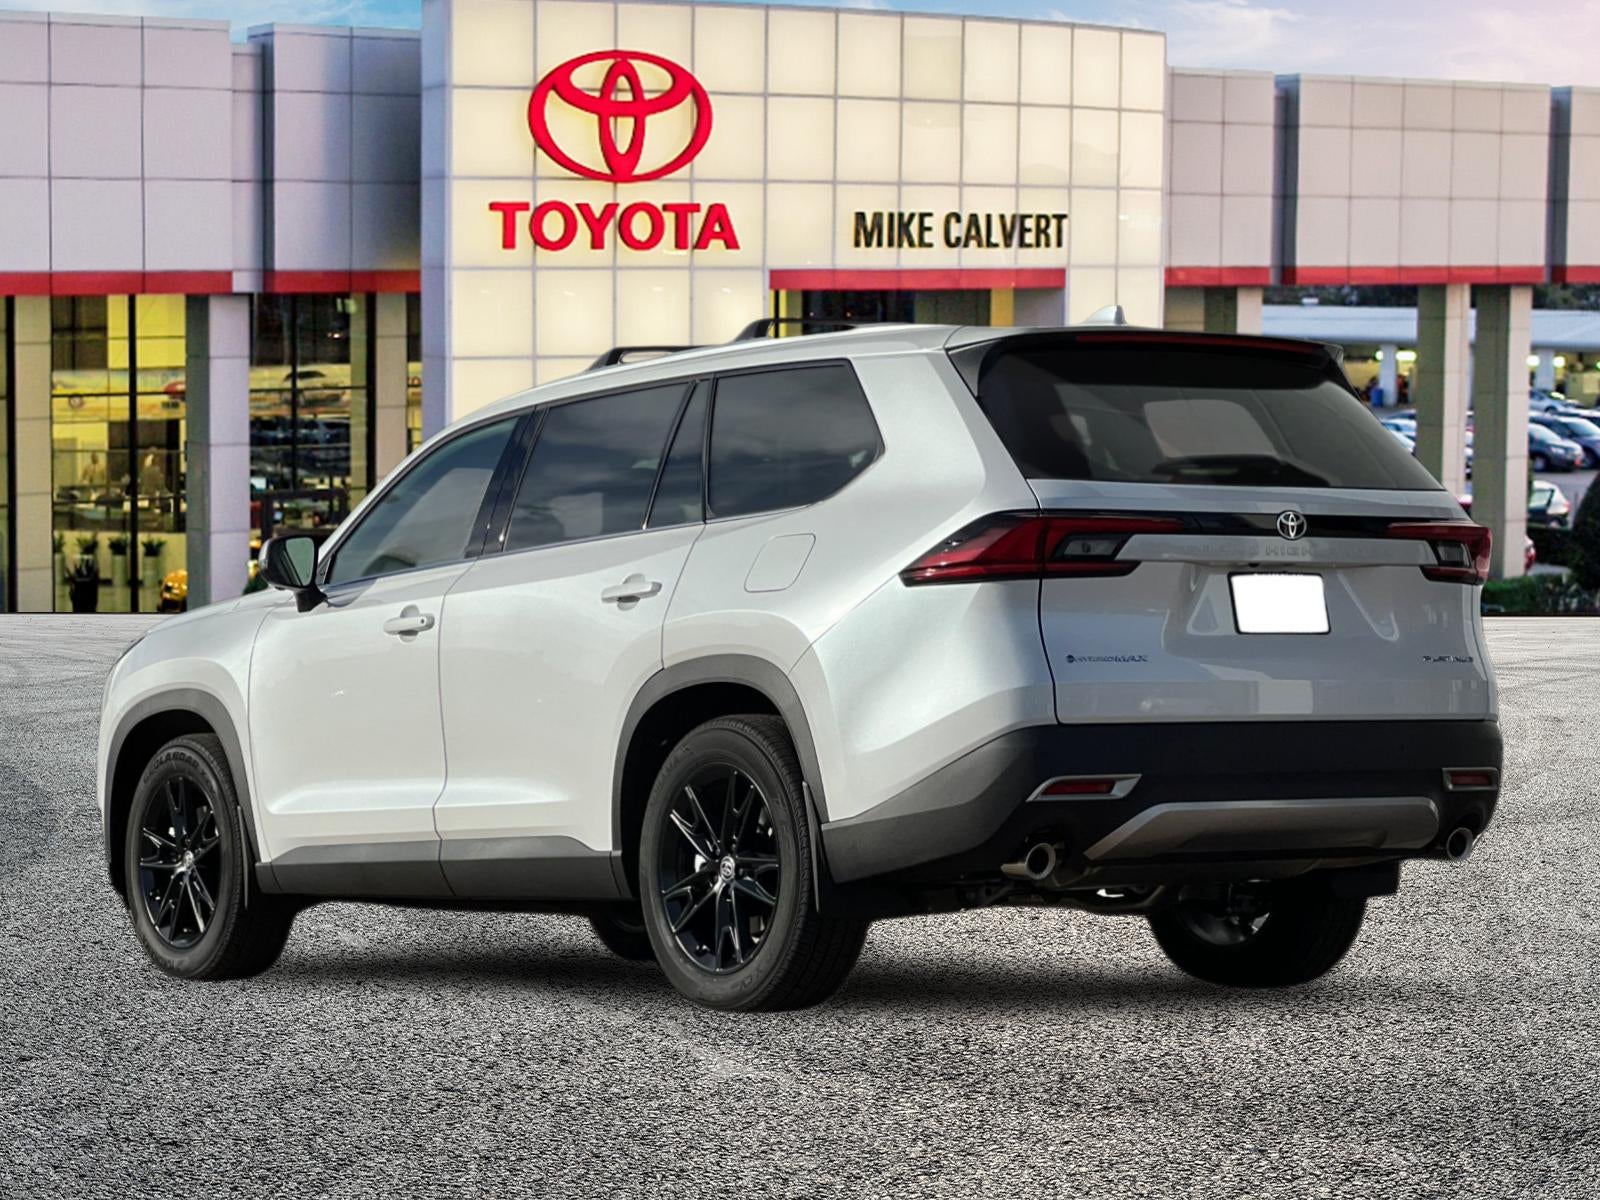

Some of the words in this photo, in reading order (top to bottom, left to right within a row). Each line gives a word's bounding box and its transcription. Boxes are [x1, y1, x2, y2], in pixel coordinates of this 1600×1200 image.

[488, 200, 741, 251] TOYOTA
[853, 211, 934, 248] MIKE
[943, 211, 1068, 249] CALVERT
